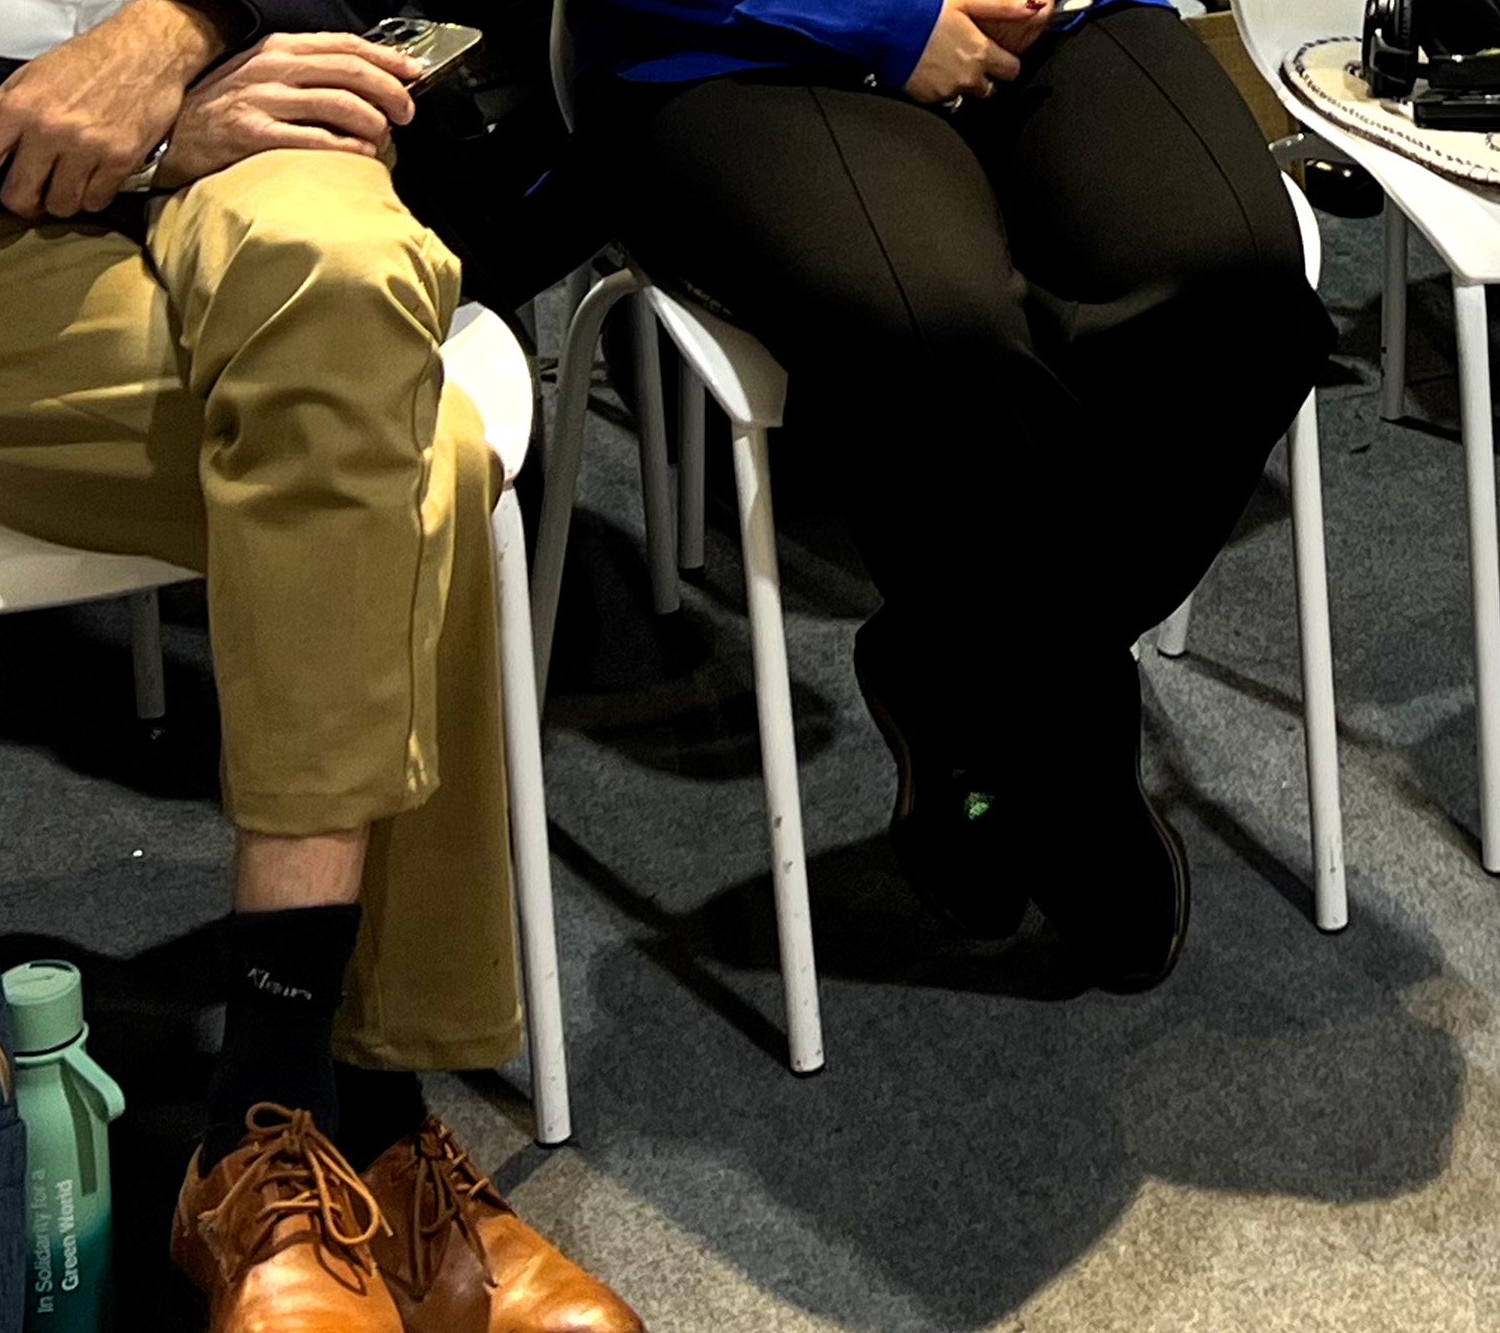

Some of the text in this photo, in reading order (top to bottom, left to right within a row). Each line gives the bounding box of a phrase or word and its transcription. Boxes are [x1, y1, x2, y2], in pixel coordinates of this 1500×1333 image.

[31, 1169, 54, 1313] In Solidarity for a
[56, 1178, 80, 1291] Green World
